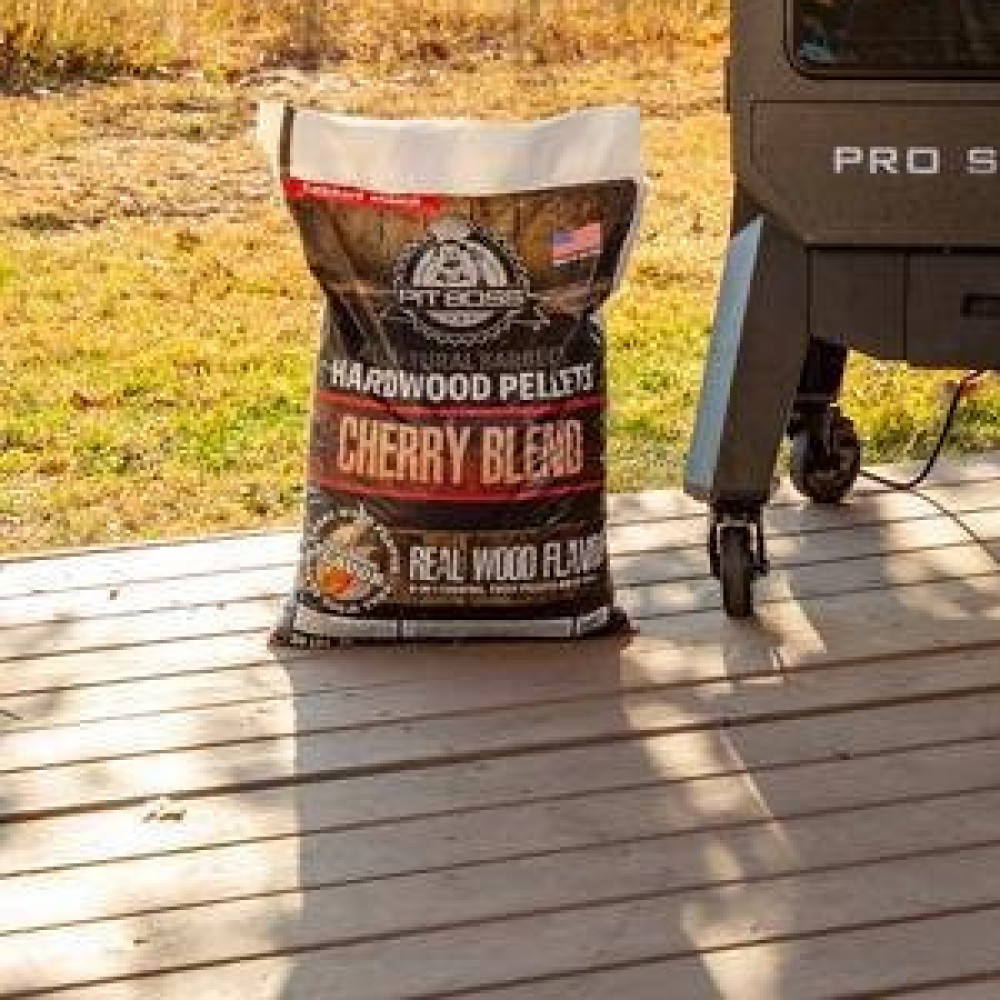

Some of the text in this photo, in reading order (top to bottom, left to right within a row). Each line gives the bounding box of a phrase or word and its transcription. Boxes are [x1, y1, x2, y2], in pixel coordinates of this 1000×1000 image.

[833, 146, 940, 174] PRO
[332, 360, 491, 401] HARDWOOD
[337, 416, 584, 484] CHERRY BLEND
[409, 545, 464, 581] REAL
[472, 545, 537, 581] WOOD
